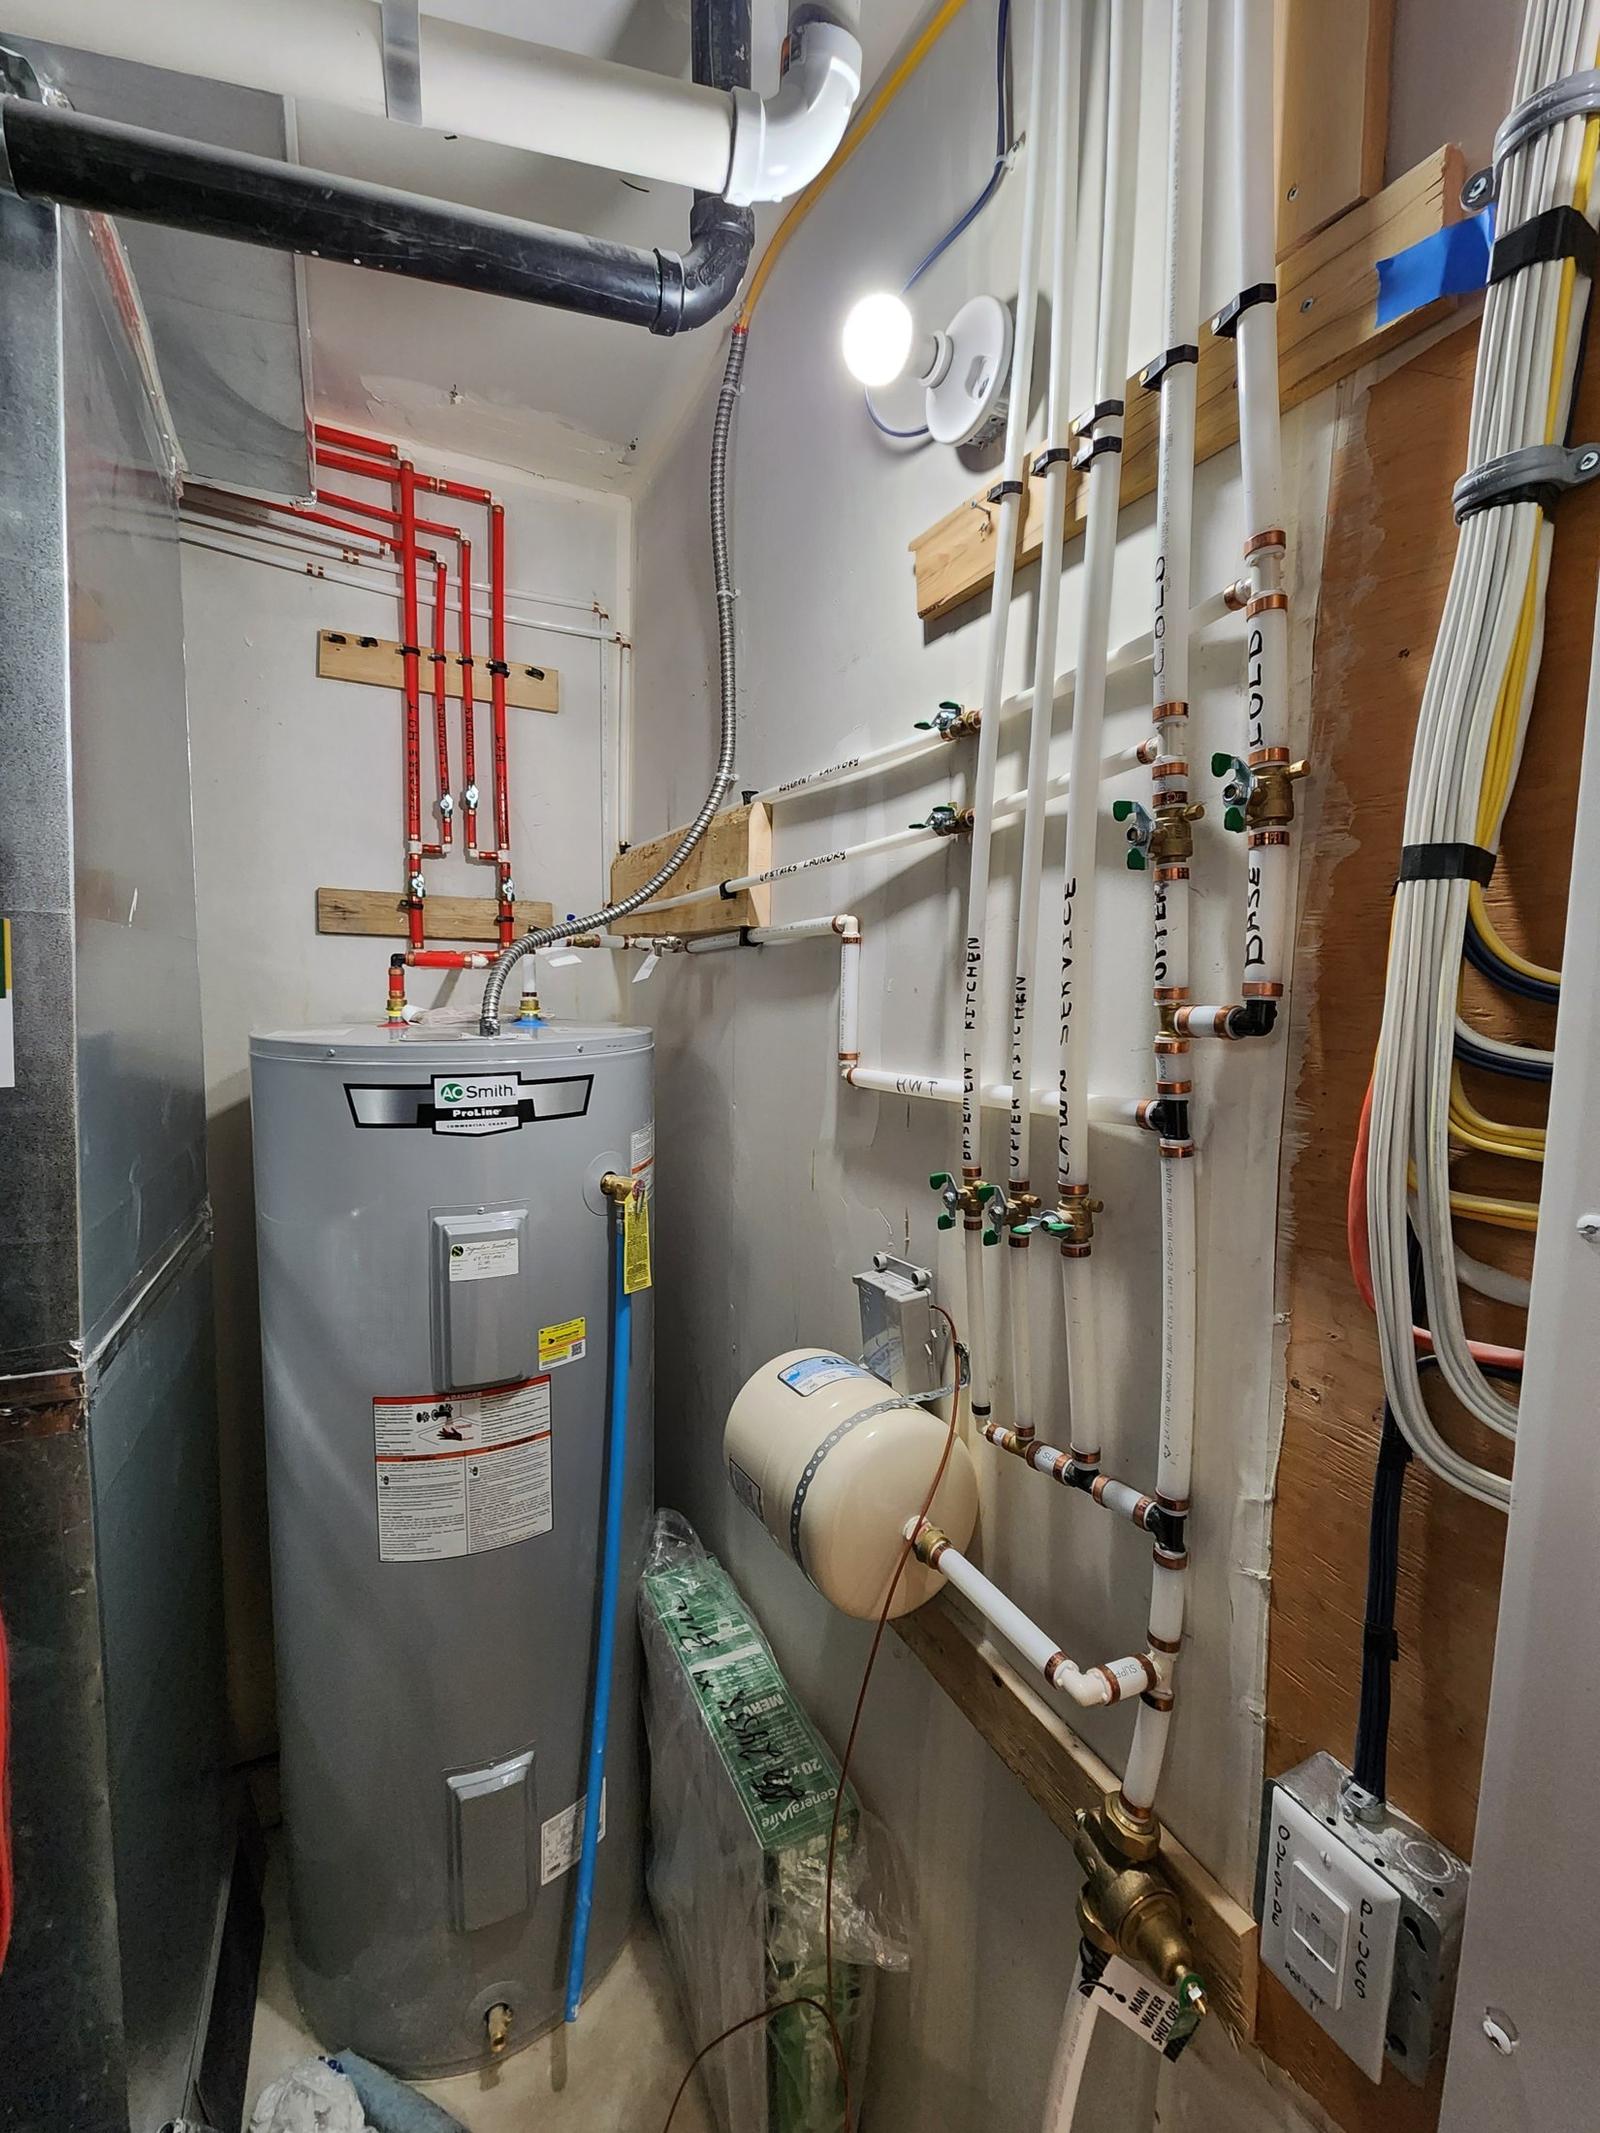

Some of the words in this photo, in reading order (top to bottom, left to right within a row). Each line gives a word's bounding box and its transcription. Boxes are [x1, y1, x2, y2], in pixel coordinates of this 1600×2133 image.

[803, 850, 847, 868] LAUNDRY
[965, 937, 981, 1030] KITCHEN
[440, 1083, 464, 1102] AO
[466, 1084, 513, 1099] Smith
[452, 1108, 500, 1118] ProLine
[761, 1787, 839, 1833] GeneralAire
[1271, 1824, 1291, 1927] OUTSIDE
[1355, 1898, 1373, 1999] PLUGS
[1128, 1986, 1150, 2016] MAIN
[1140, 1995, 1166, 2029] WATER
[1151, 2013, 1172, 2045] SHUT
